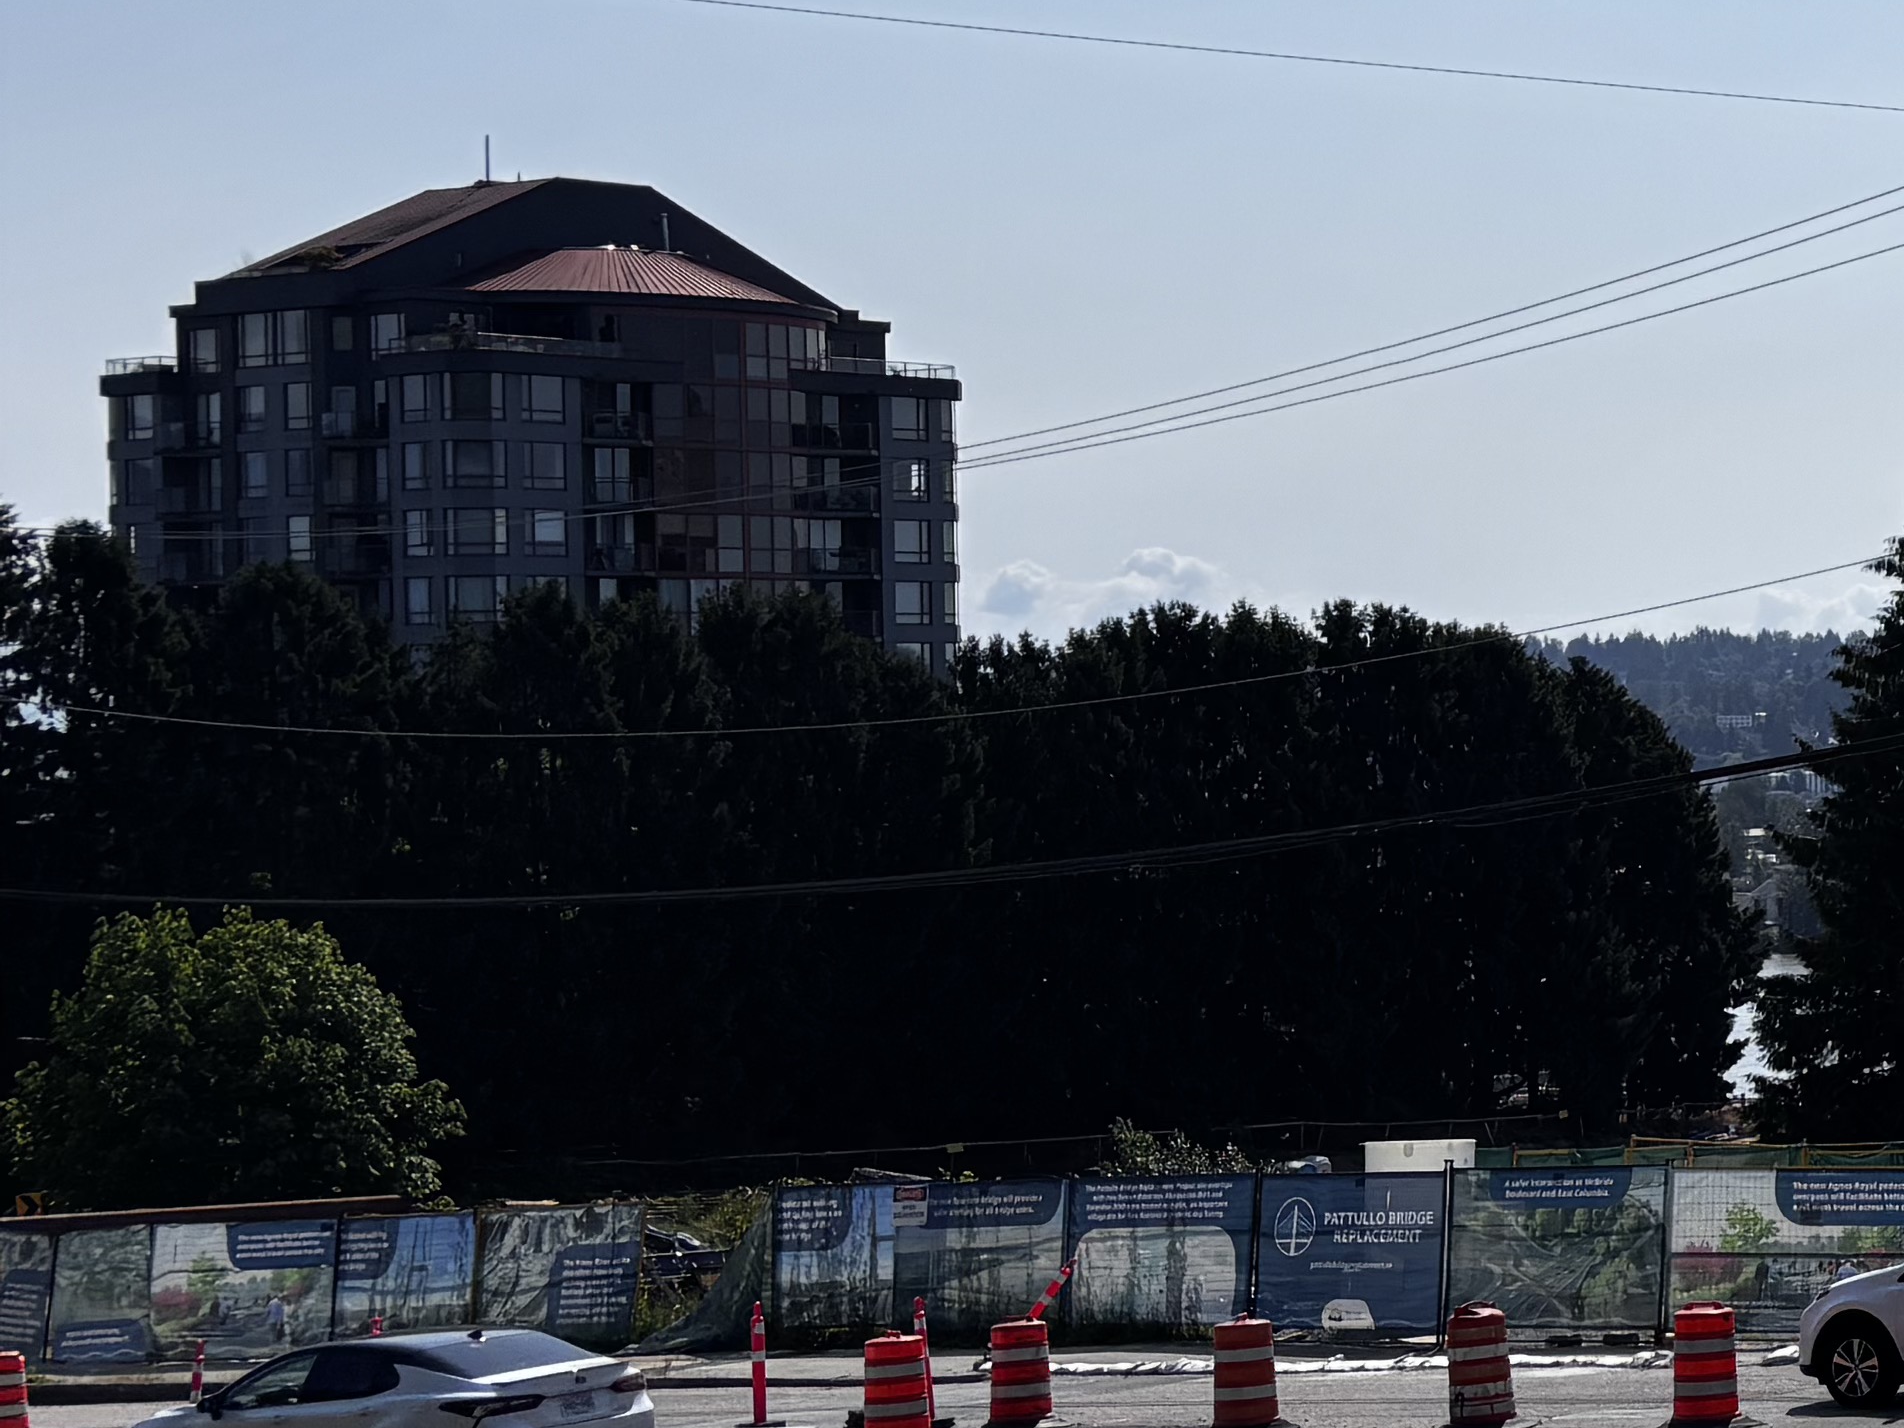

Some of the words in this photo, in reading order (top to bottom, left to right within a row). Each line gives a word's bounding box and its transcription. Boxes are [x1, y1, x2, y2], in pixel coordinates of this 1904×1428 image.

[1324, 1211, 1386, 1226] PATTULLO
[1388, 1211, 1434, 1225] BRIDGE
[1333, 1229, 1423, 1243] REPLACEMENT
